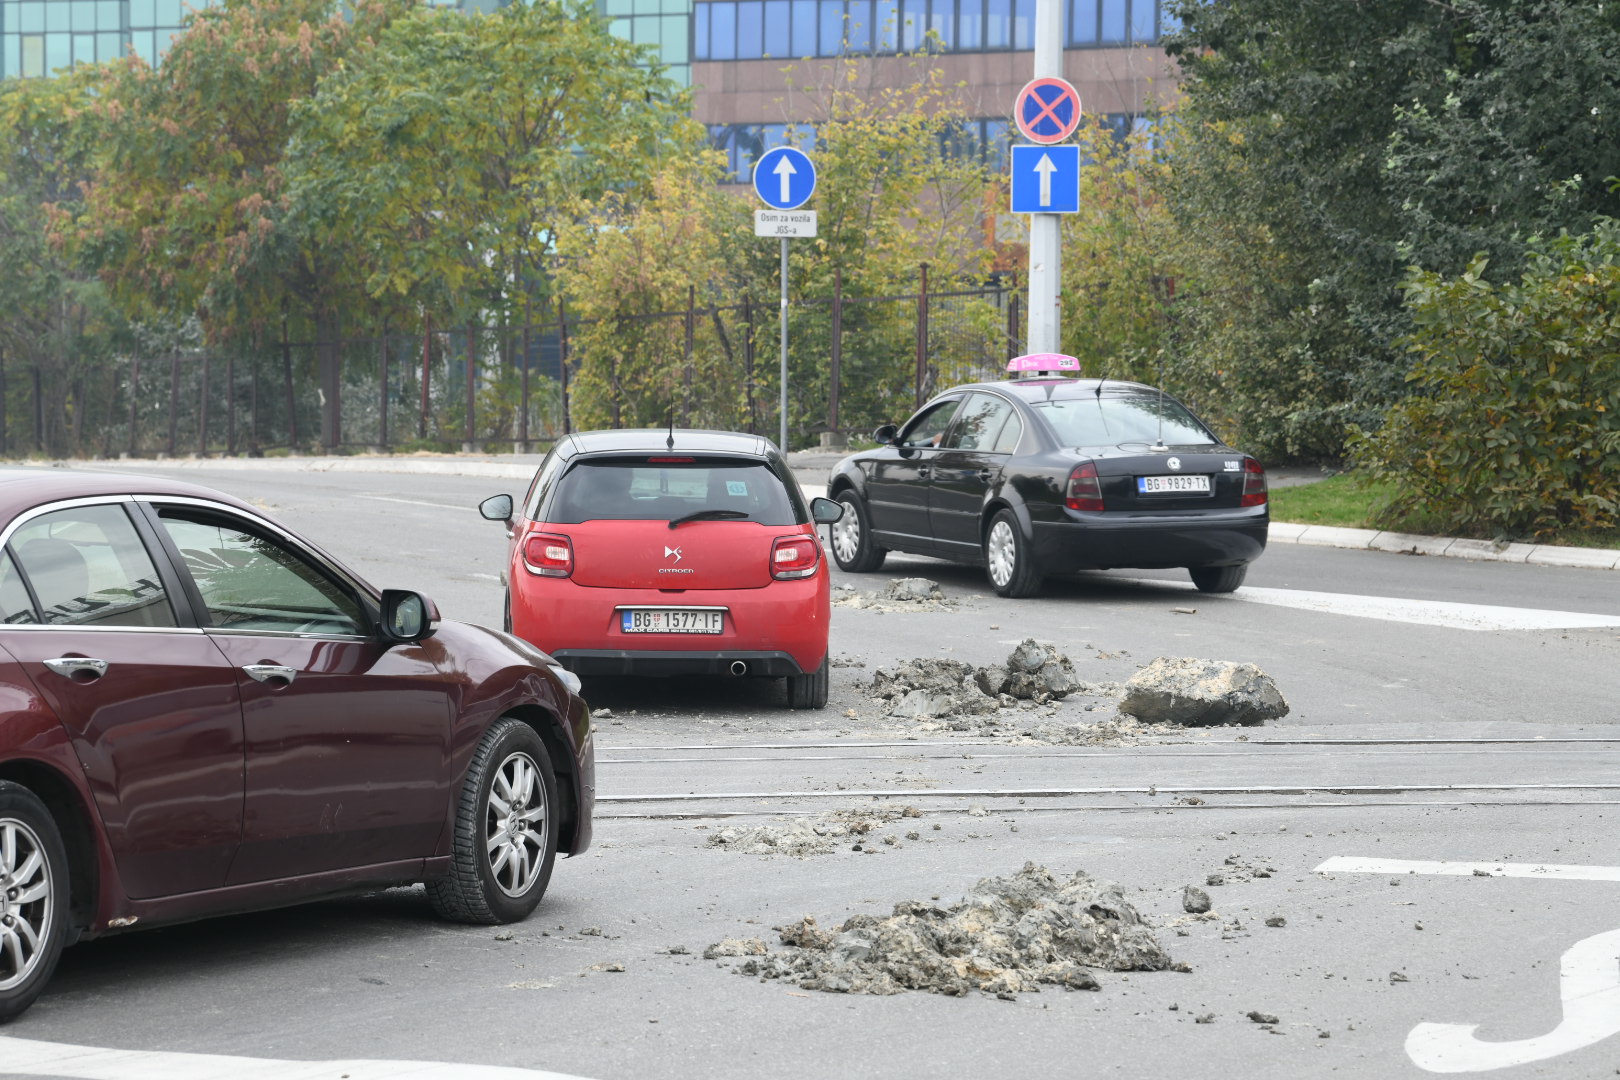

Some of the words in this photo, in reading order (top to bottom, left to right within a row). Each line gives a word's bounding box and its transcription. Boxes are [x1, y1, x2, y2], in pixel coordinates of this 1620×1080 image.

[761, 213, 778, 222] Osim
[791, 214, 811, 223] vozila
[1146, 478, 1160, 491] BG
[634, 612, 651, 628] BG
